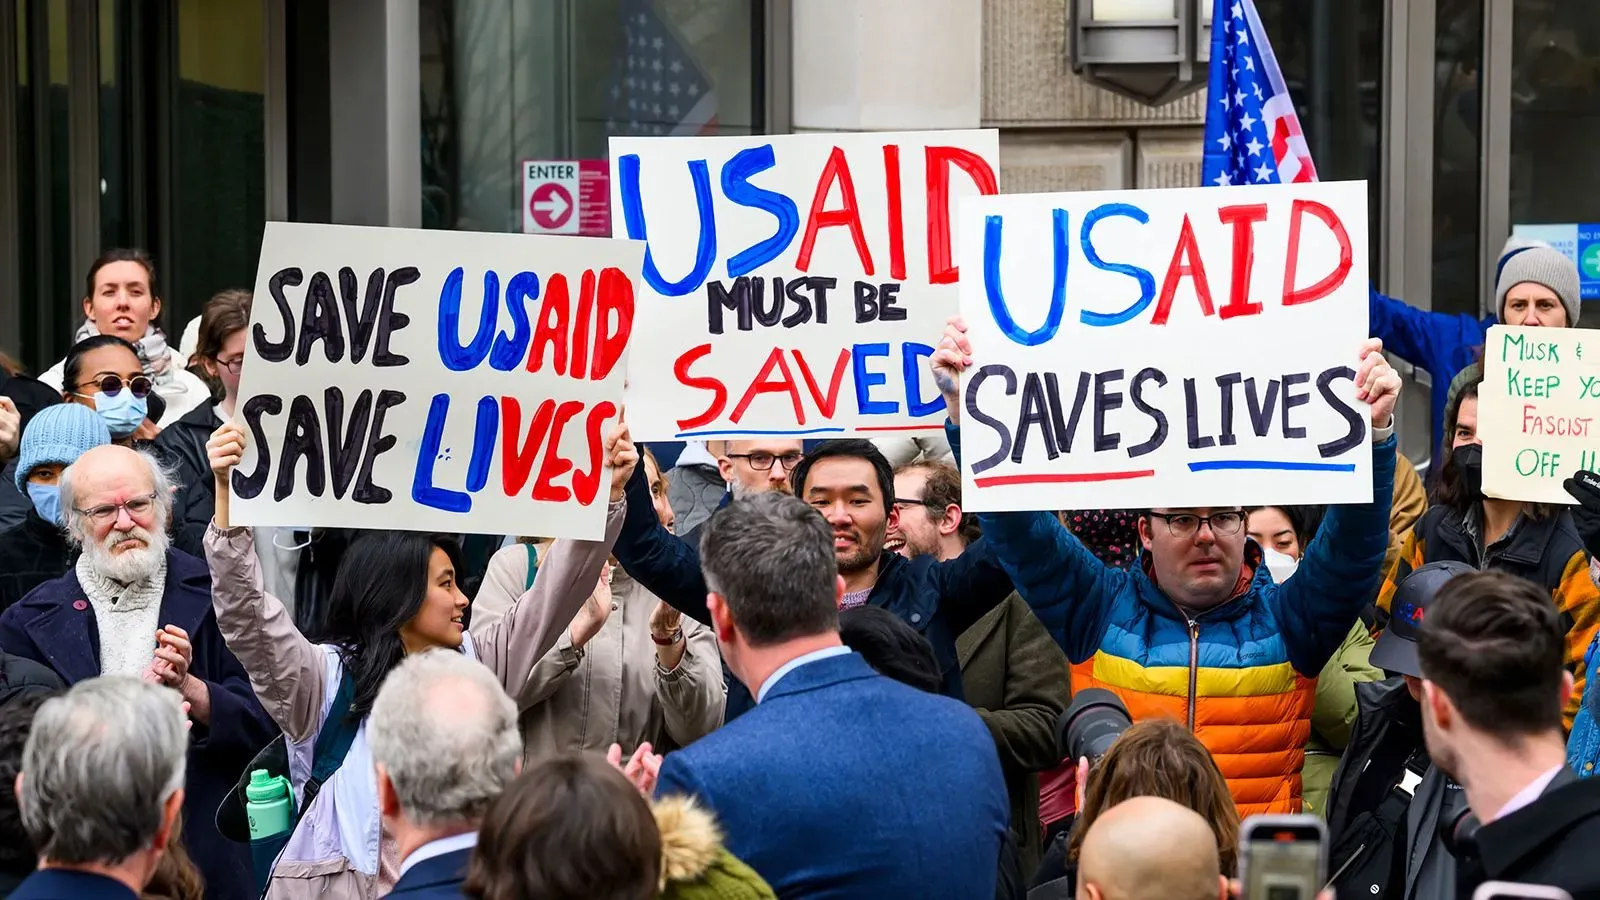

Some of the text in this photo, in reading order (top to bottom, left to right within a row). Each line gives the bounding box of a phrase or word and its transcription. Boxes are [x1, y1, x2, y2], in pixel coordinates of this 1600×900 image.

[528, 165, 574, 179] ENTER
[618, 144, 998, 297] USAID
[707, 276, 908, 335] MUST BE
[984, 199, 1353, 347] USAID
[252, 266, 635, 381] SAVE USAID
[1502, 333, 1560, 364] MUSK
[673, 341, 947, 430] SAVED
[965, 364, 1366, 475] SAVES LIVES
[1507, 367, 1561, 399] KEEP
[231, 386, 616, 513] SAVE LIVES
[1522, 404, 1593, 437] FASCIST
[1515, 448, 1561, 478] OFF
